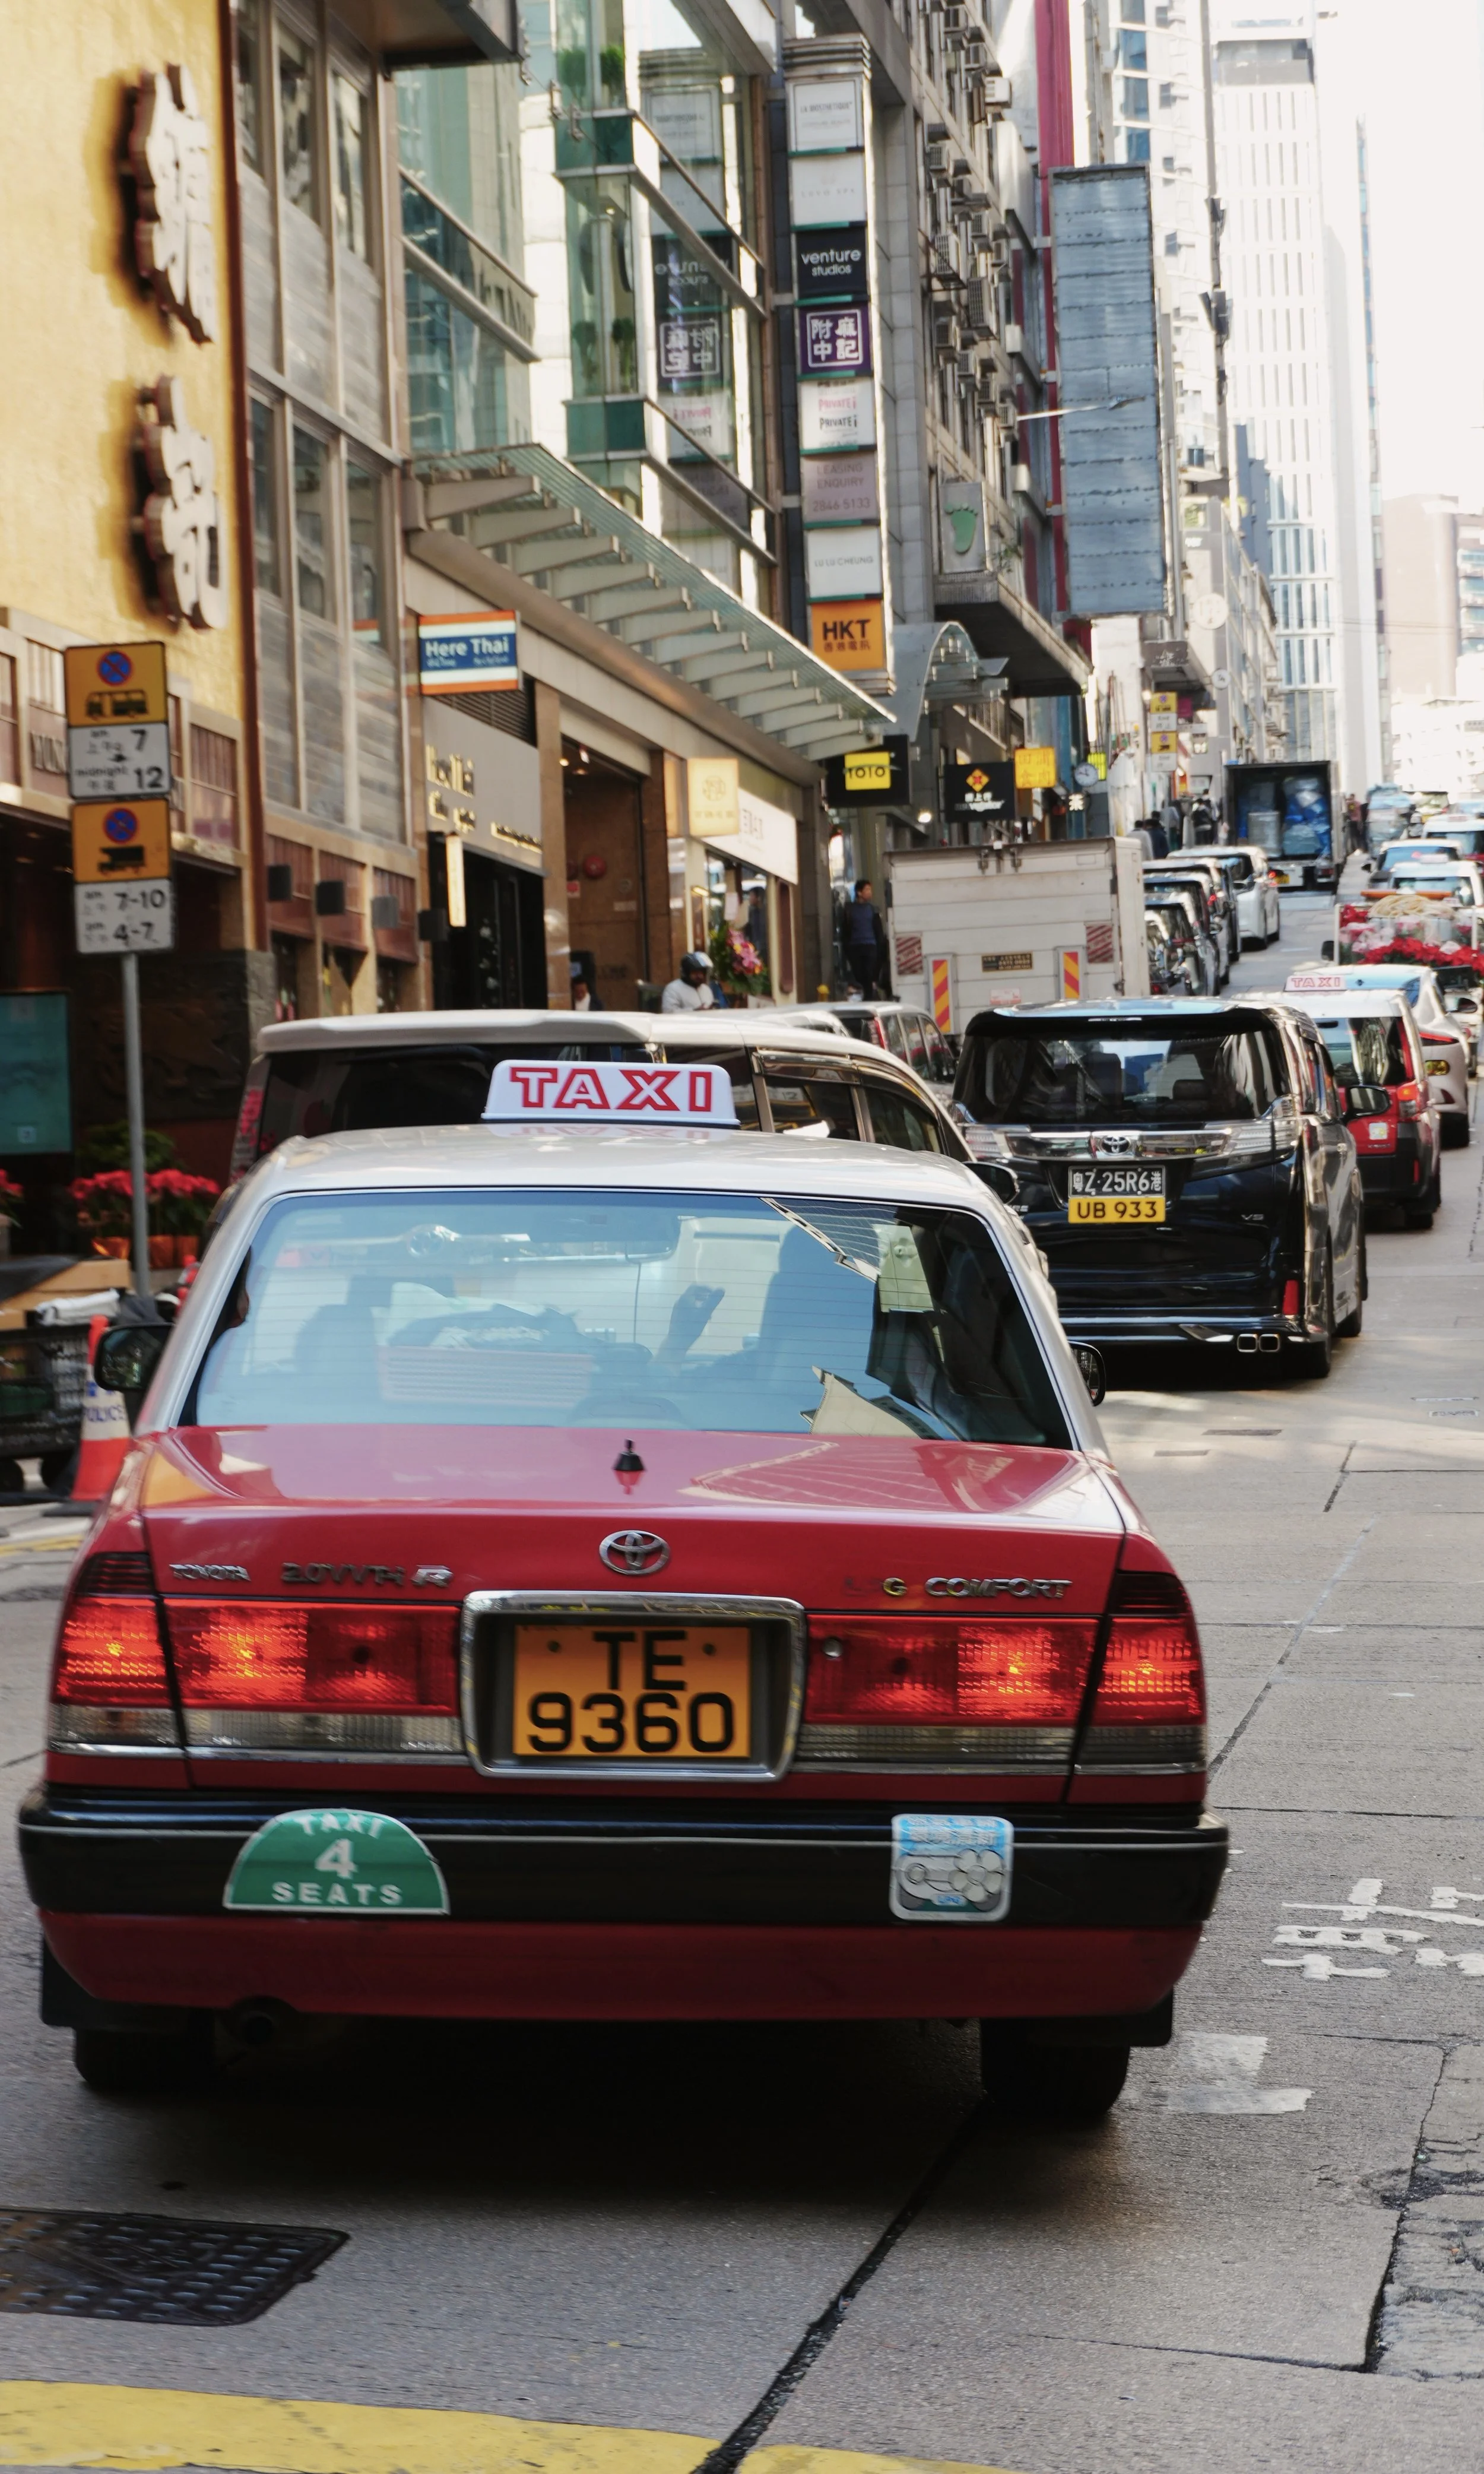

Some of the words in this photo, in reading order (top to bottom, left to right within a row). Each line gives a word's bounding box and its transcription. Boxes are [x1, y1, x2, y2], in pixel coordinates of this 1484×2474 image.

[801, 248, 861, 265] venture
[811, 264, 852, 277] studios
[819, 416, 851, 430] PRIVATE
[817, 464, 863, 475] LEASING
[817, 477, 864, 489] ENQUIRY
[813, 499, 839, 512] 2846
[842, 498, 871, 511] 5133
[838, 556, 874, 566] CHEUNG
[822, 619, 871, 641] HKT
[424, 640, 468, 658] Here
[470, 635, 510, 655] Thai
[131, 729, 147, 752] 7
[134, 766, 163, 789] 12
[113, 889, 166, 911] 7-10
[113, 923, 154, 946] 4-7
[1290, 977, 1341, 988] TAXI
[509, 1066, 712, 1112] TAXI
[1077, 1202, 1106, 1219] UB
[1114, 1201, 1157, 1219] 933
[924, 1577, 1073, 1598] COMFORT
[592, 1629, 689, 1691] TE
[527, 1691, 735, 1753] 9360
[293, 1812, 388, 1839] TAXI
[315, 1838, 358, 1880] 4
[271, 1881, 404, 1905] SEATS
